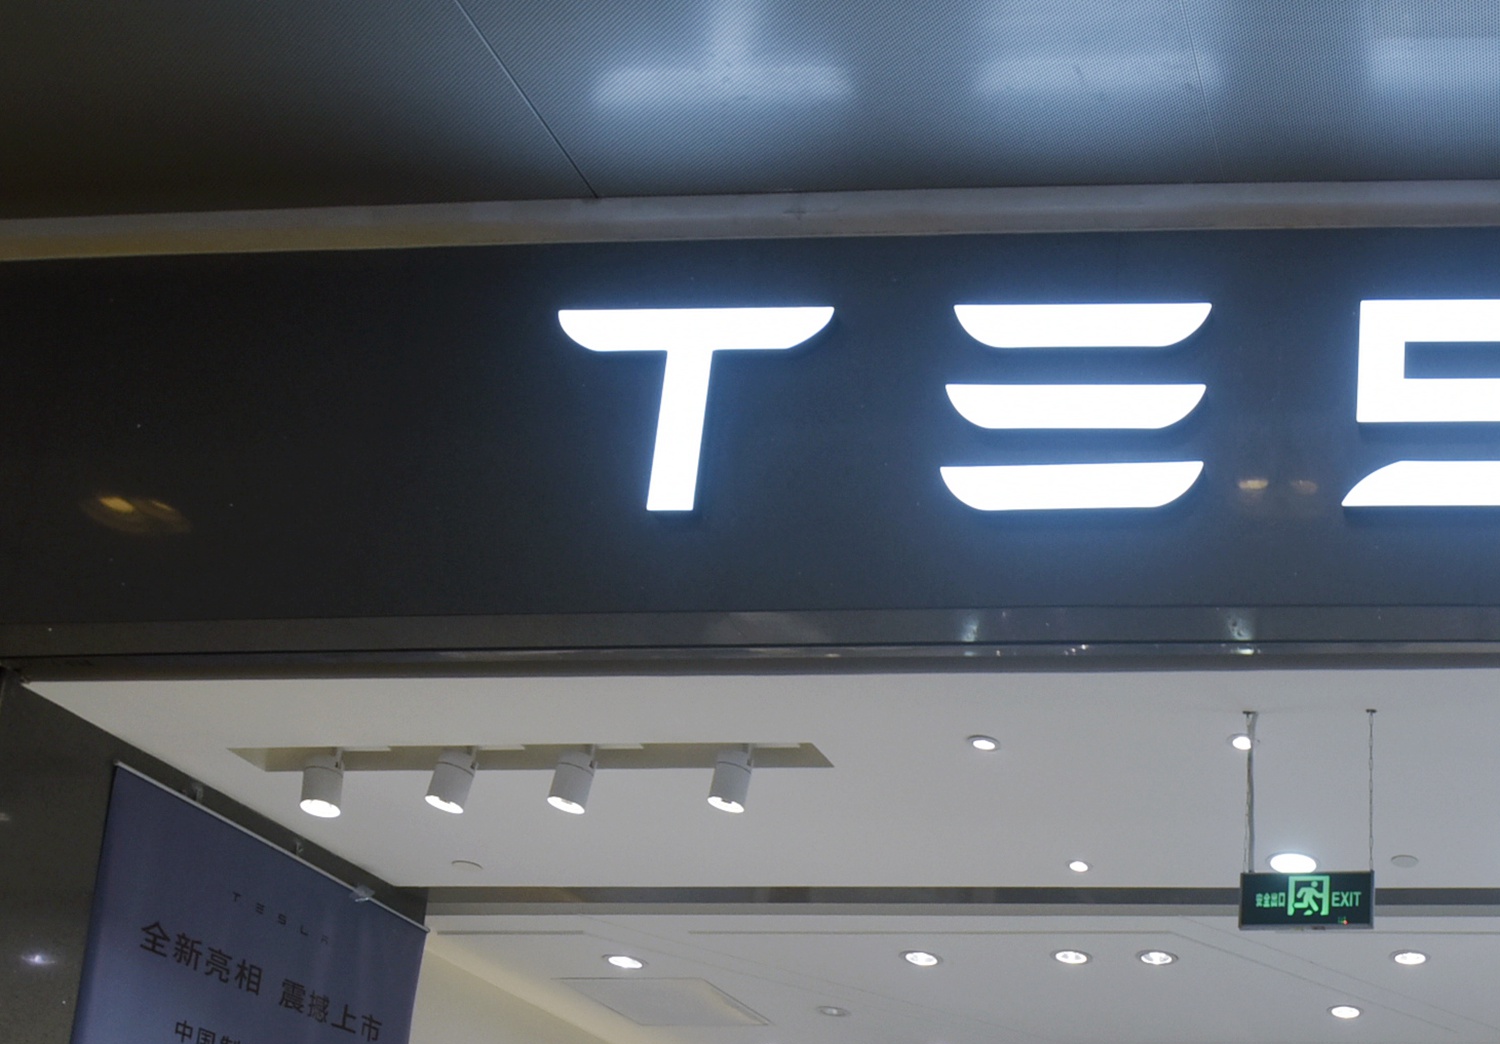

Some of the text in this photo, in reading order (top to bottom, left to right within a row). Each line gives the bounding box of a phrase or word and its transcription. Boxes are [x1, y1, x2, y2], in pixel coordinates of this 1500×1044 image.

[232, 891, 329, 945] TESLA
[1255, 891, 1362, 908] 安全出口 EXIT
[140, 921, 383, 1043] 全新亮相 震撼上市
